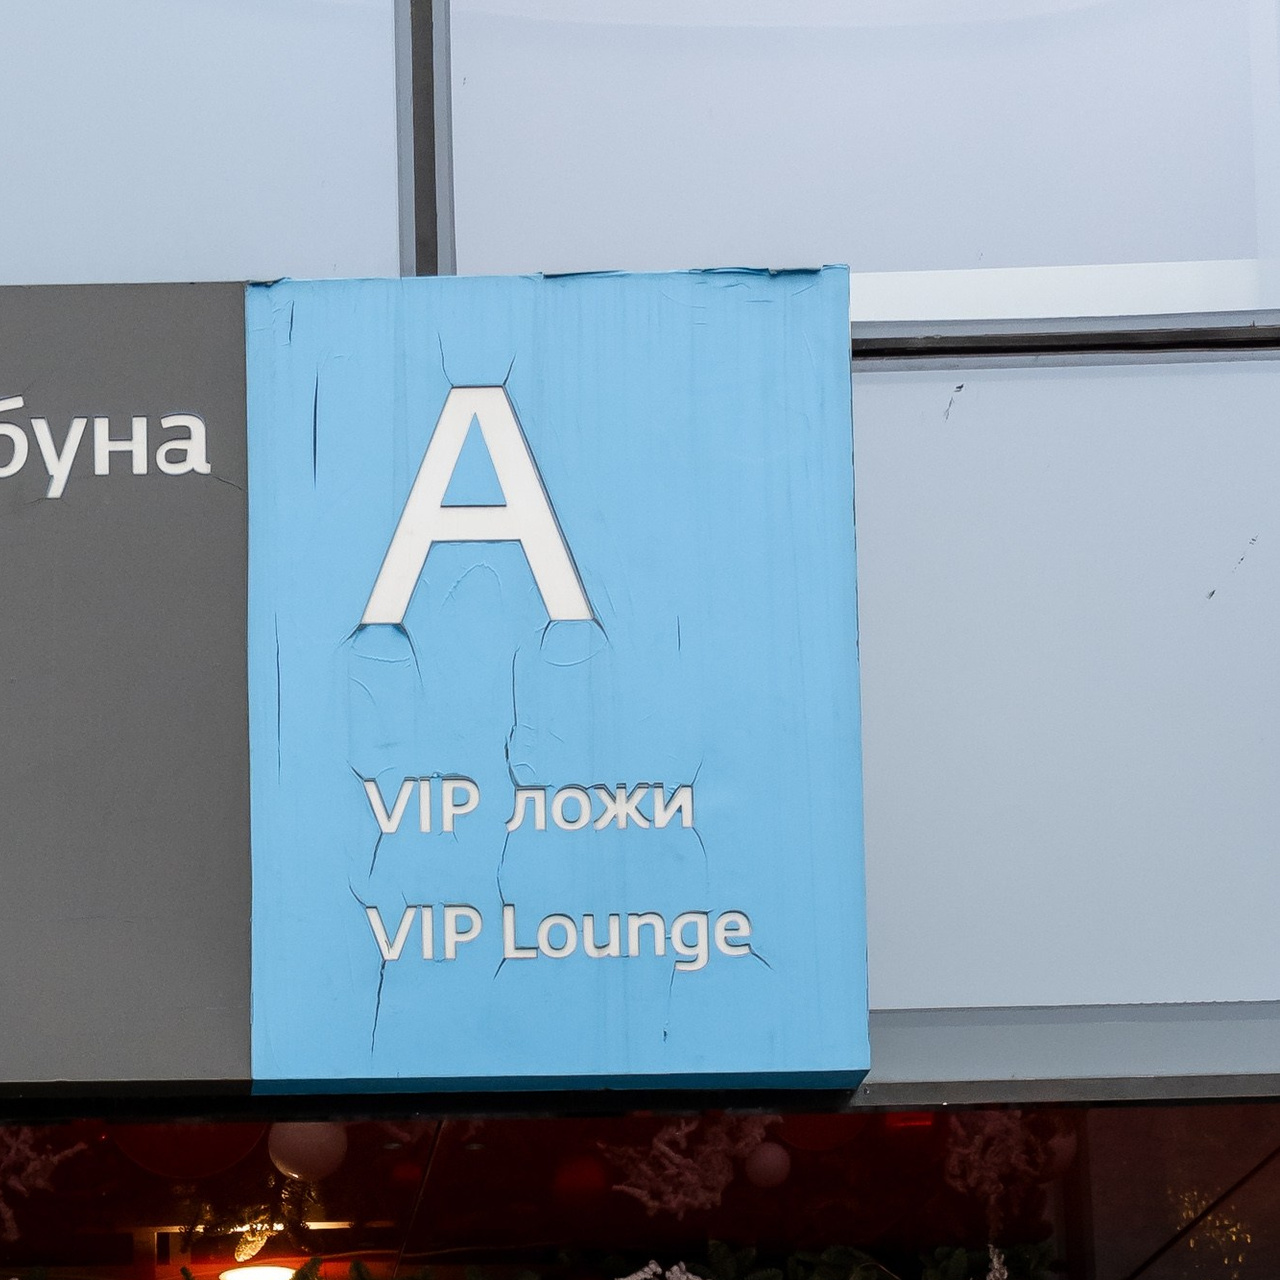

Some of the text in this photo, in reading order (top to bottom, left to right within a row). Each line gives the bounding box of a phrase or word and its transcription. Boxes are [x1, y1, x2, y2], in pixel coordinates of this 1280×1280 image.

[363, 778, 694, 834] VIP ложи
[365, 904, 753, 971] VIP Lounge
